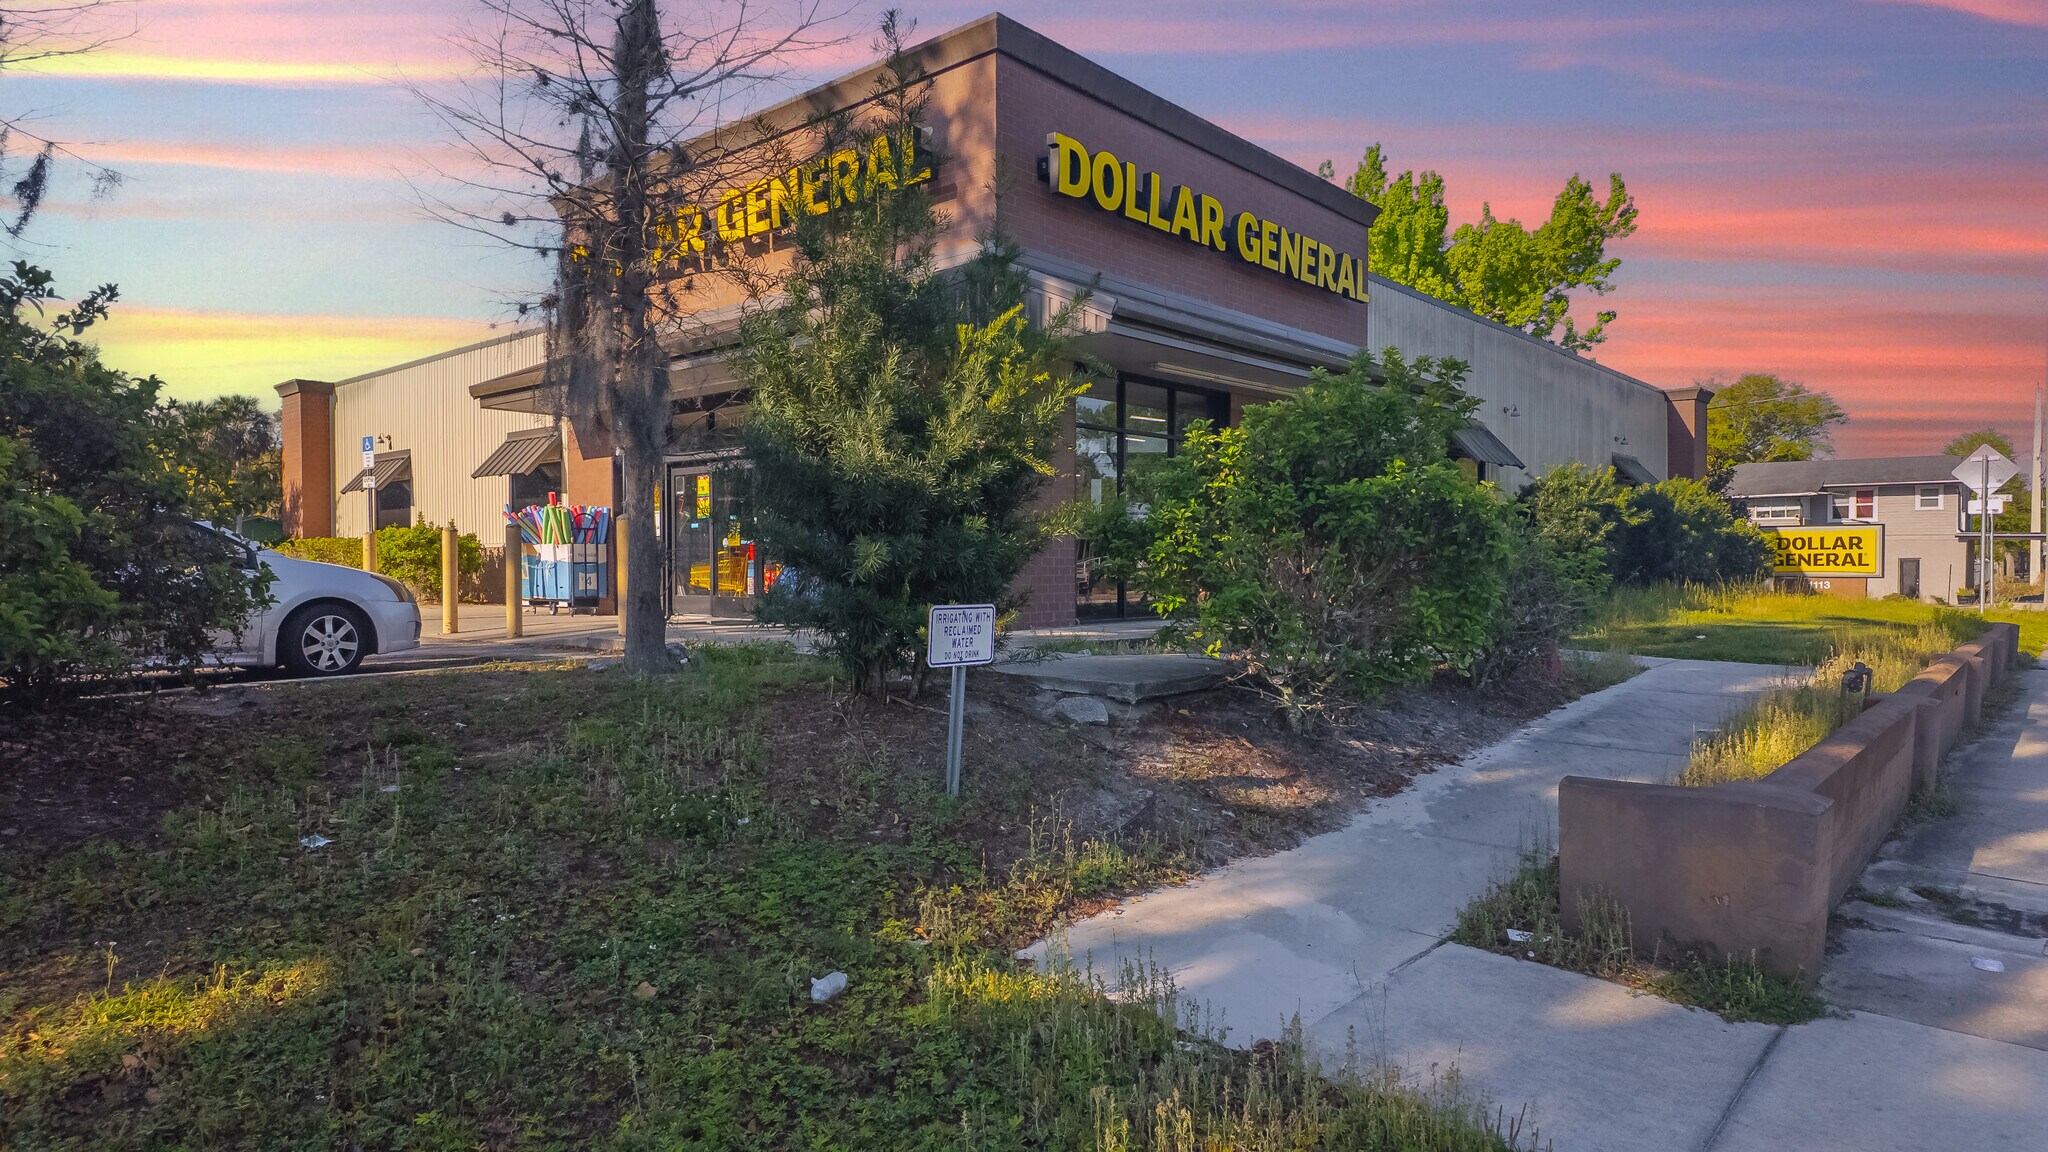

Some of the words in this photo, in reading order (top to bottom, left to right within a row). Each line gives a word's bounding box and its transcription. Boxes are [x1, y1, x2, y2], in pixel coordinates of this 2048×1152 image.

[716, 125, 931, 243] GENERAL
[1050, 132, 1226, 251] DOLLAR
[1236, 211, 1370, 303] GENERAL
[1776, 536, 1863, 551] DOLLAR
[1774, 552, 1870, 567] GENERAL
[935, 612, 973, 624] IRRIGATING
[975, 611, 991, 623] WITH
[943, 624, 982, 637] RECLAIMED
[951, 637, 974, 649] WATER
[944, 651, 952, 660] DO
[953, 651, 963, 660] NOT
[965, 649, 980, 659] DRINK
